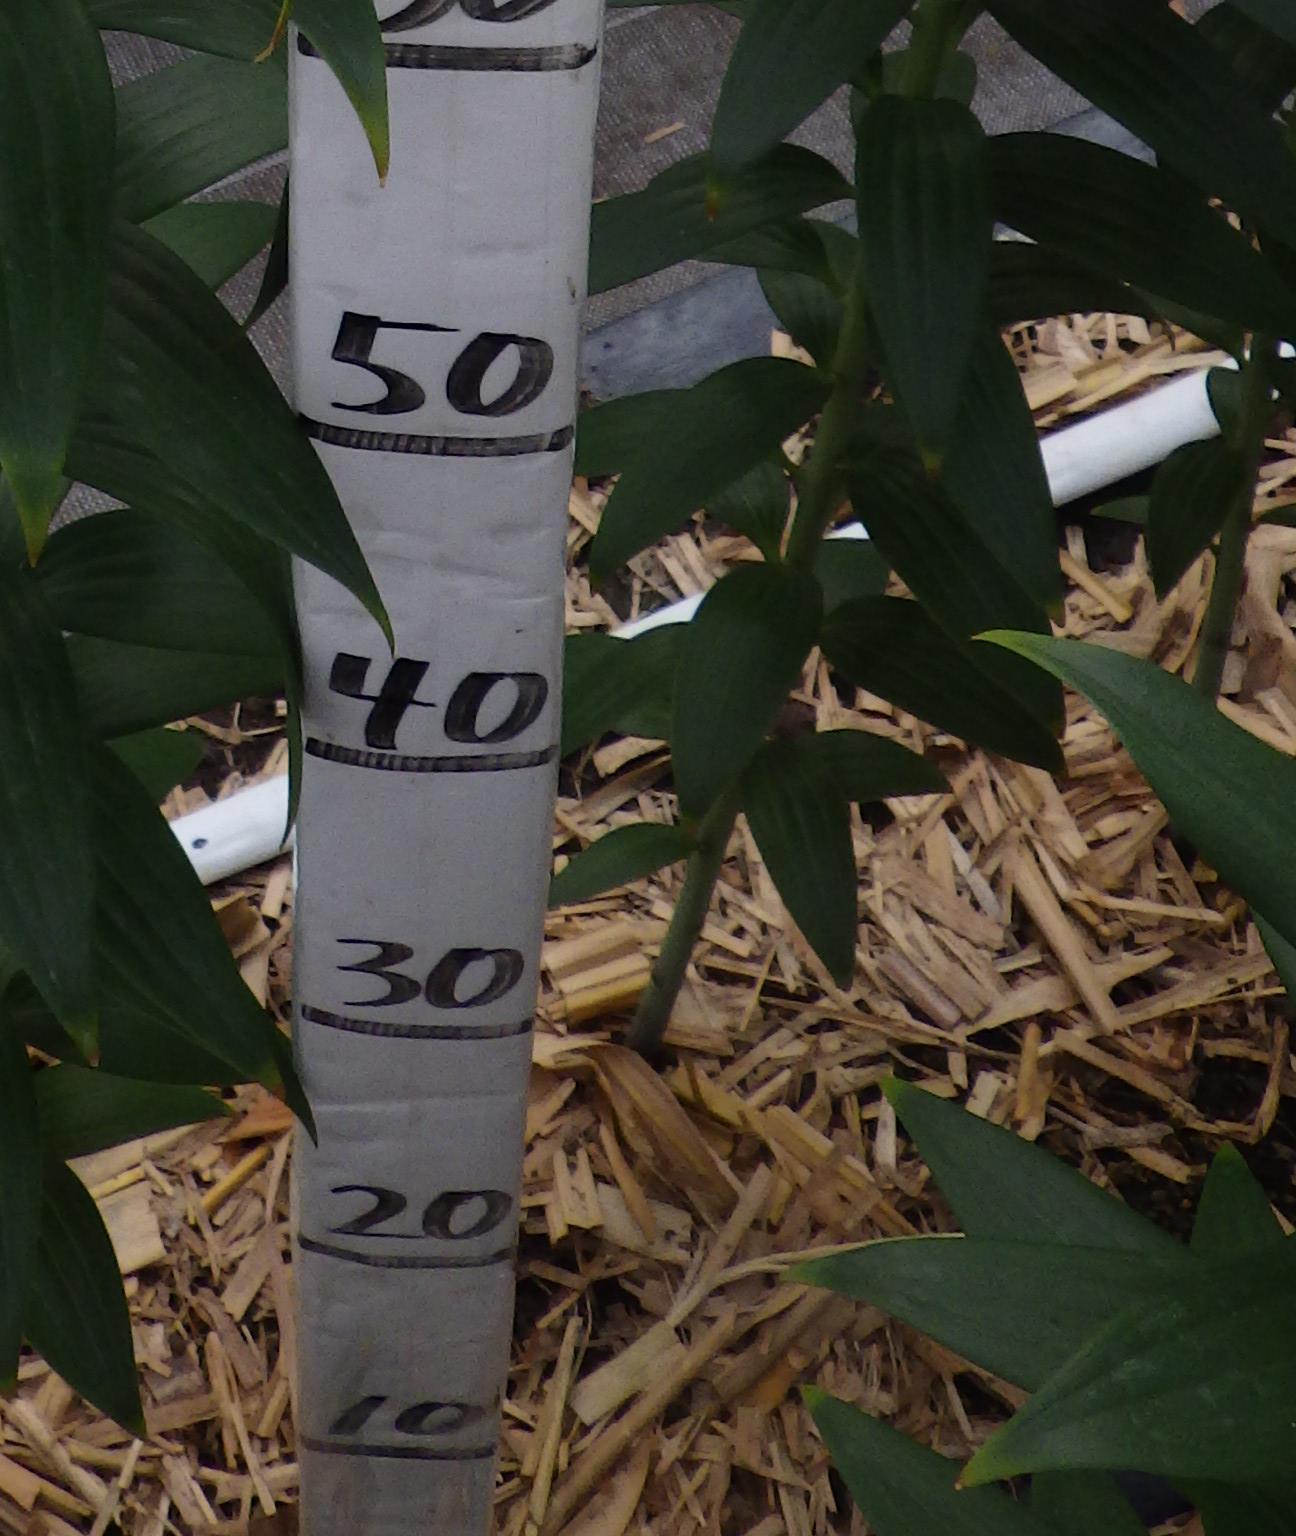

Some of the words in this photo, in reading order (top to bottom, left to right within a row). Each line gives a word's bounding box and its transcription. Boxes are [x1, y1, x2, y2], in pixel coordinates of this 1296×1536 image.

[330, 310, 554, 417] 50
[328, 651, 549, 750] 40
[336, 938, 525, 1009] 30
[329, 1184, 512, 1240] 20
[328, 1395, 485, 1436] 10
